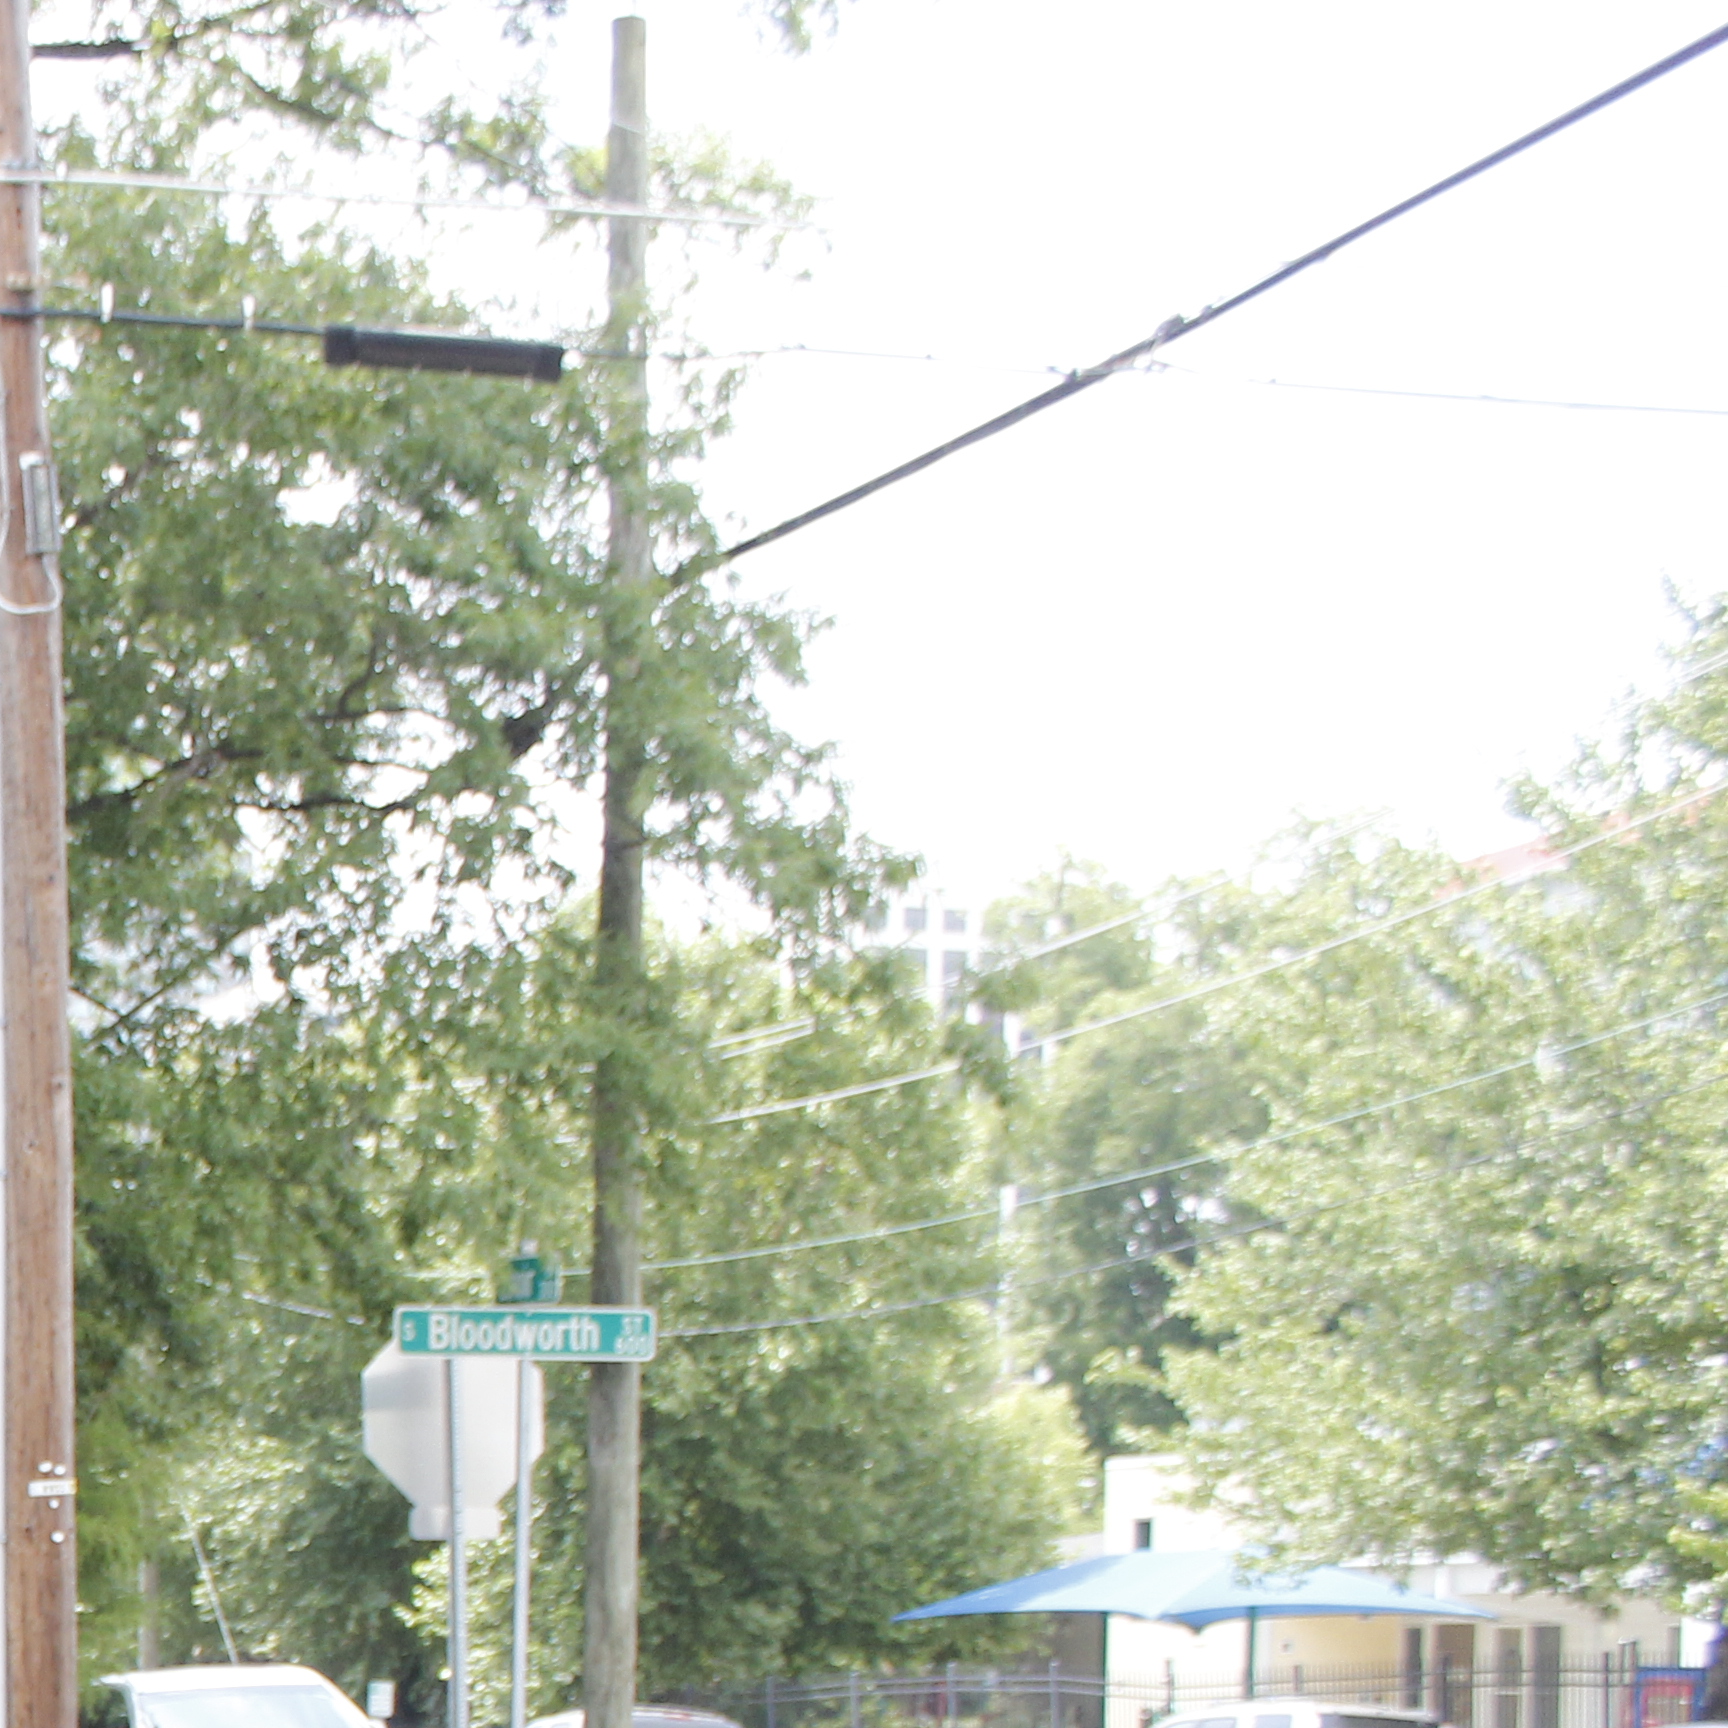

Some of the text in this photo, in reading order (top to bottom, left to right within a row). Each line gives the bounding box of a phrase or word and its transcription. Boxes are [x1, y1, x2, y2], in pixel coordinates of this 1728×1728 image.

[402, 1313, 644, 1352] S Bloodworth ST
